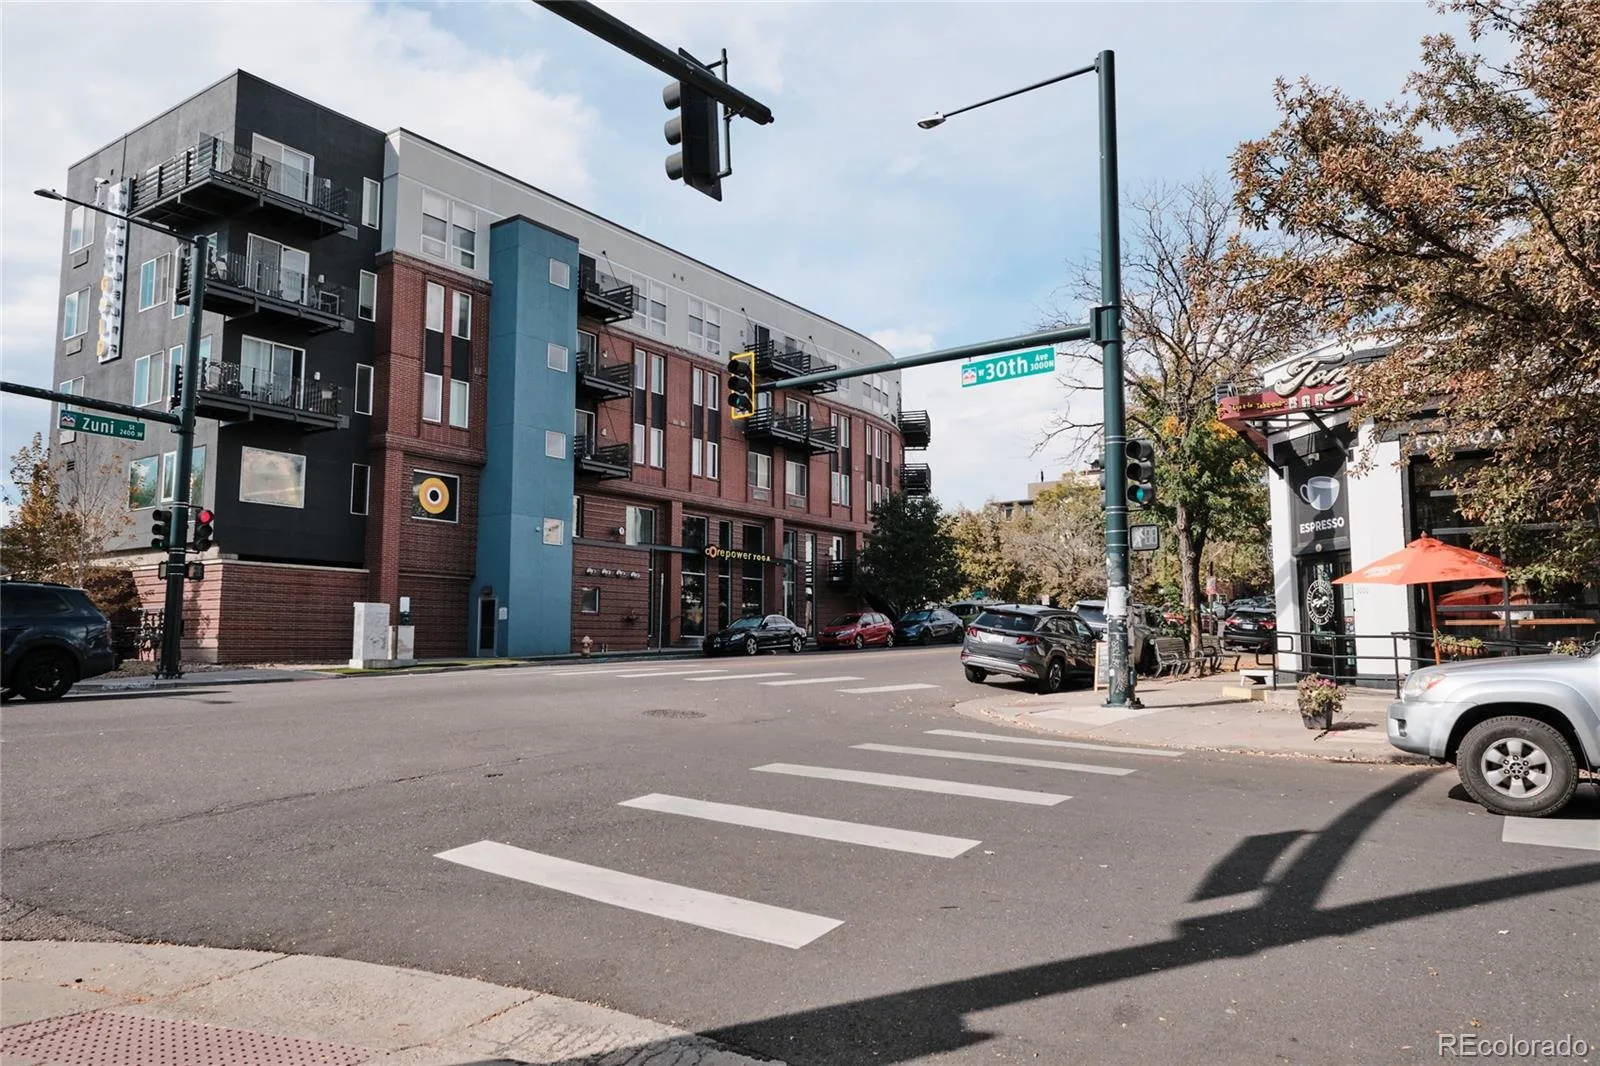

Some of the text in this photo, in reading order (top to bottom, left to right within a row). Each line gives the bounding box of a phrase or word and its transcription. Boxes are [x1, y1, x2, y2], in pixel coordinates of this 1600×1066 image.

[1034, 353, 1049, 362] Ave
[985, 356, 1029, 380] 30th
[82, 417, 115, 434] Zuni
[119, 428, 136, 437] 2400
[1299, 516, 1345, 534] ESPRESSO
